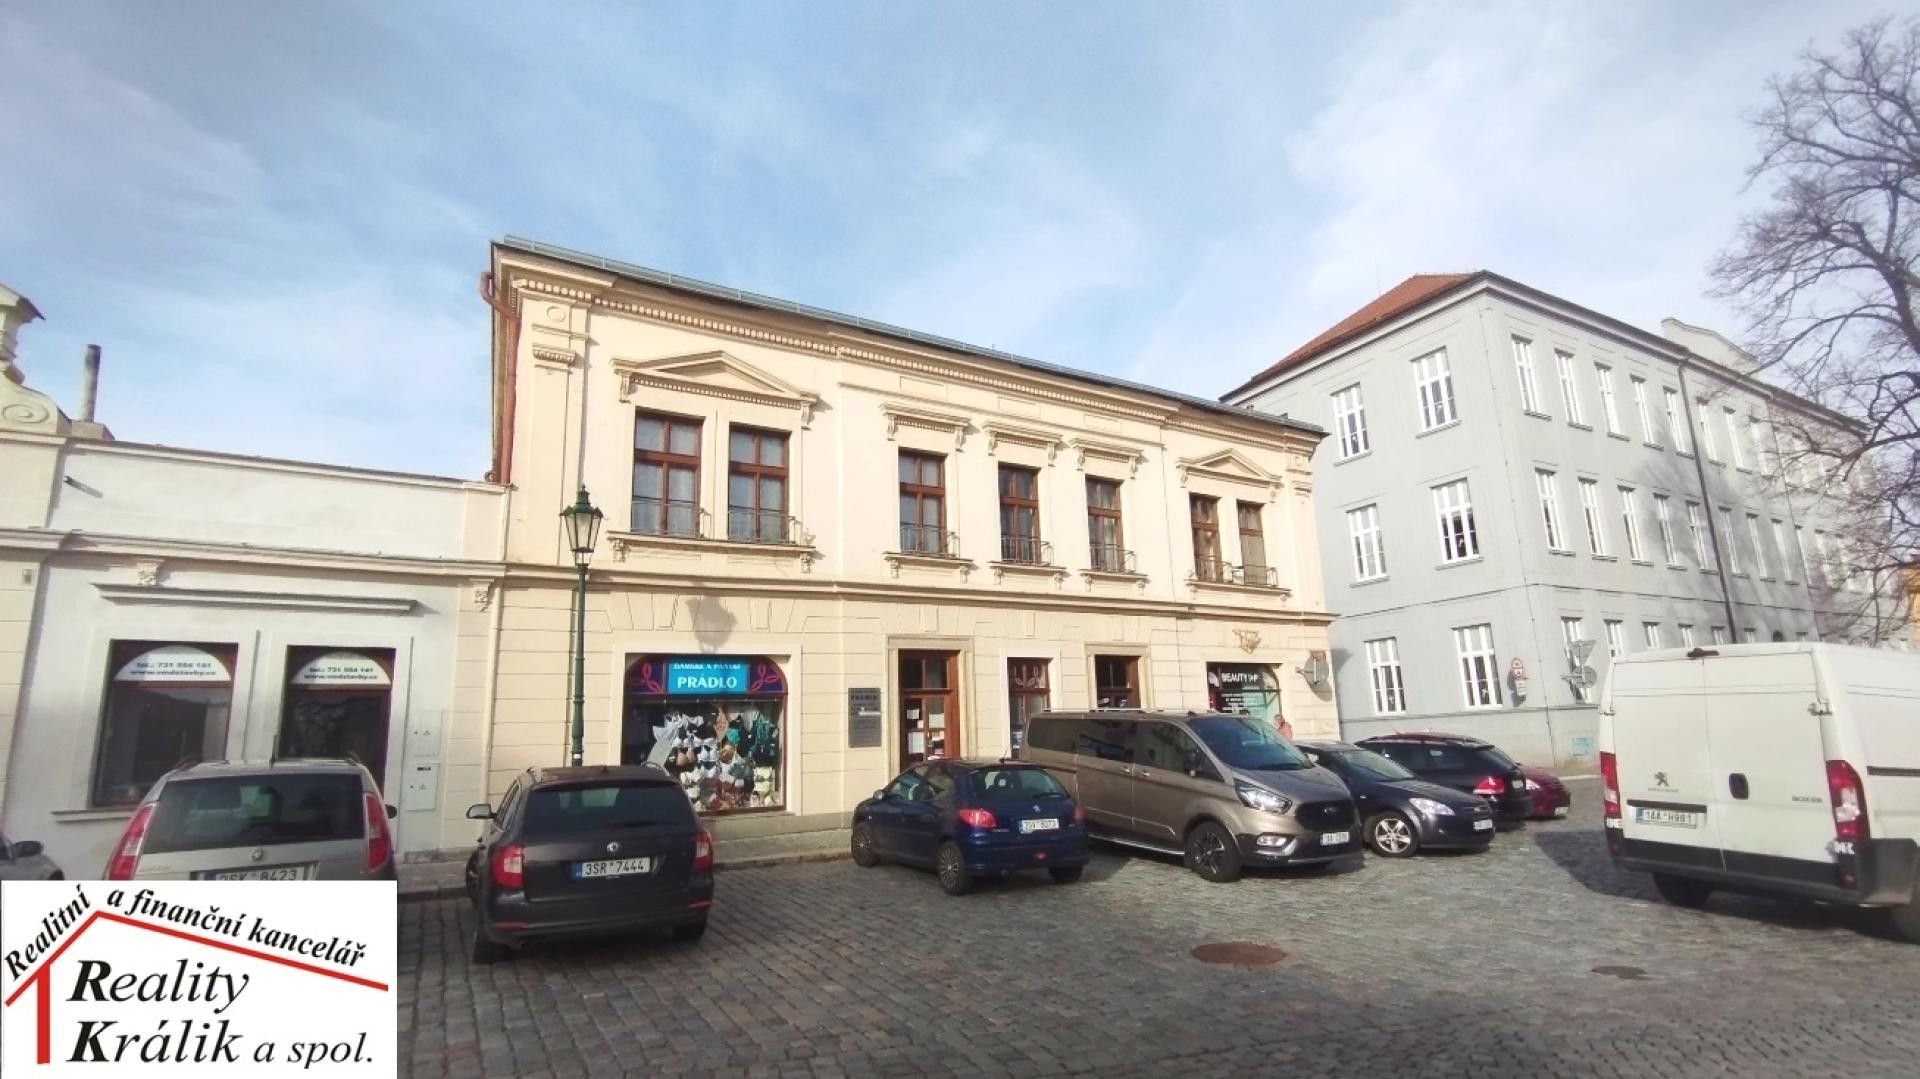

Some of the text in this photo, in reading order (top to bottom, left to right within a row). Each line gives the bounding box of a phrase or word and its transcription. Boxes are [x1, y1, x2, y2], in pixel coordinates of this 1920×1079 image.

[677, 673, 738, 689] PRÁDLO
[1221, 672, 1247, 683] BEAUTY
[585, 859, 644, 876] 3SR 7444
